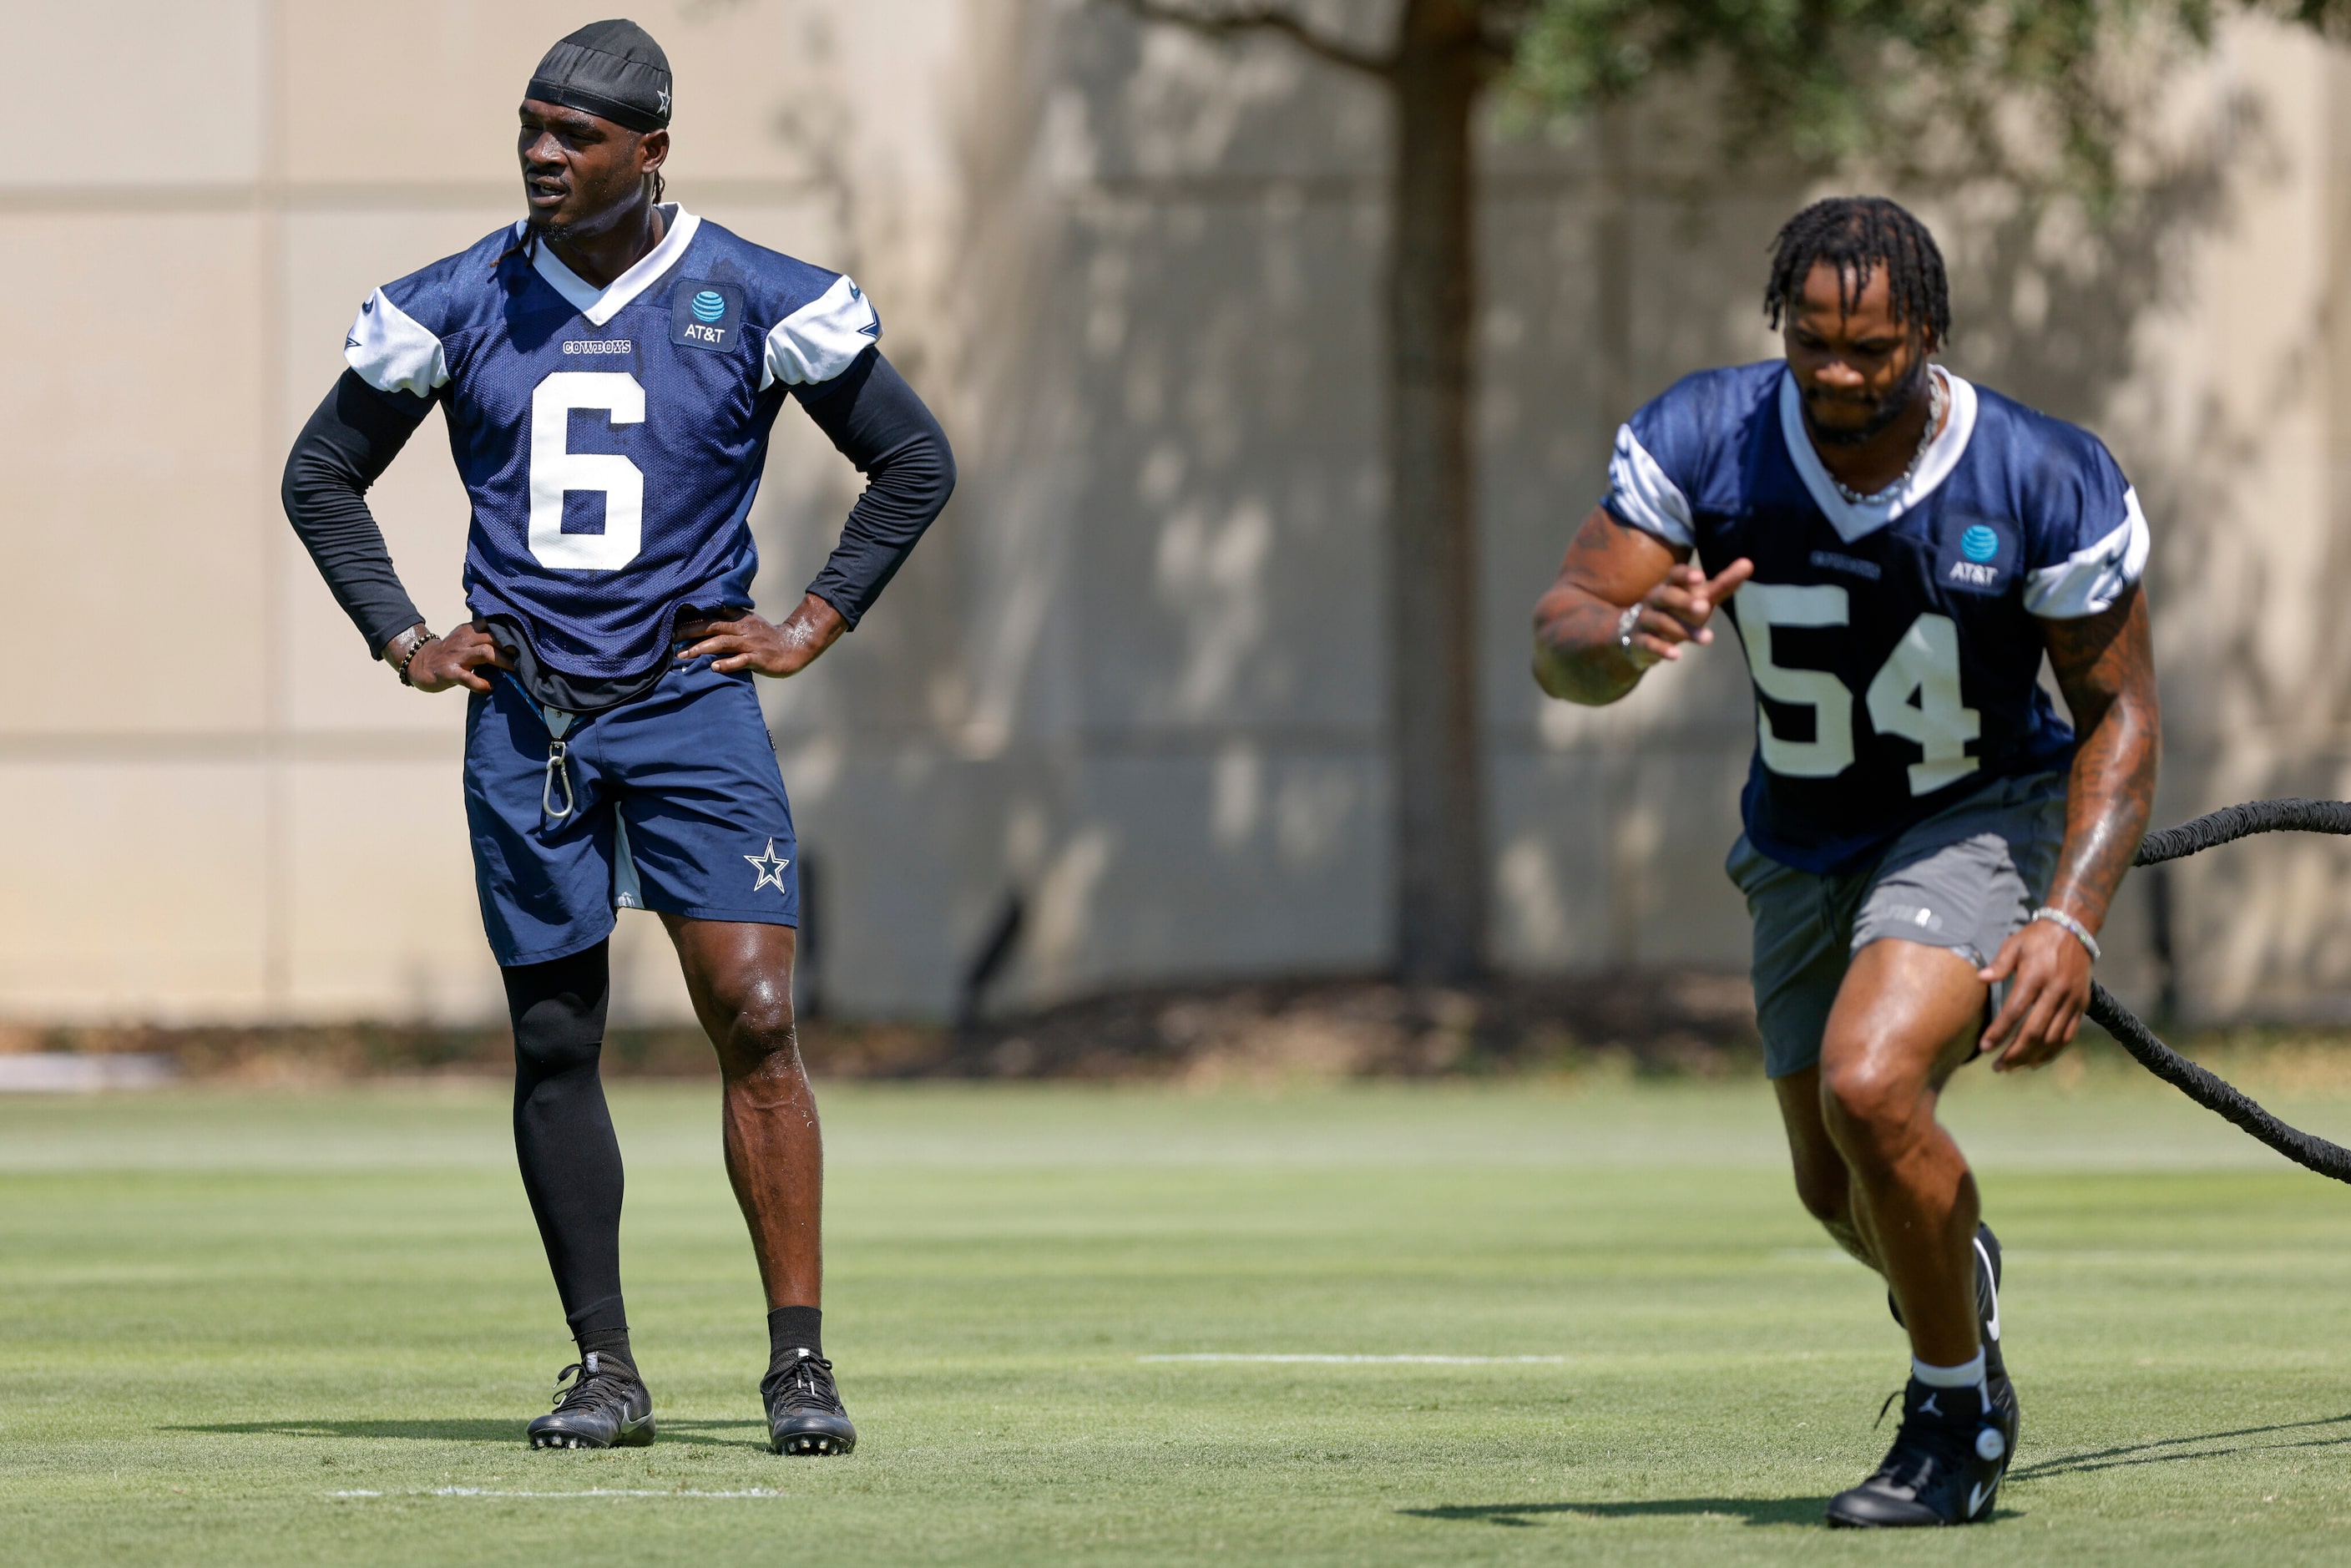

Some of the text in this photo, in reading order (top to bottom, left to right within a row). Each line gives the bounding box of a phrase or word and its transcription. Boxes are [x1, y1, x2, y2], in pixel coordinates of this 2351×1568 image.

[563, 339, 631, 354] COWBOYS
[684, 324, 725, 343] AT&T
[528, 372, 645, 570] 6
[1949, 561, 1999, 587] AT&T
[1734, 581, 1980, 797] 54
